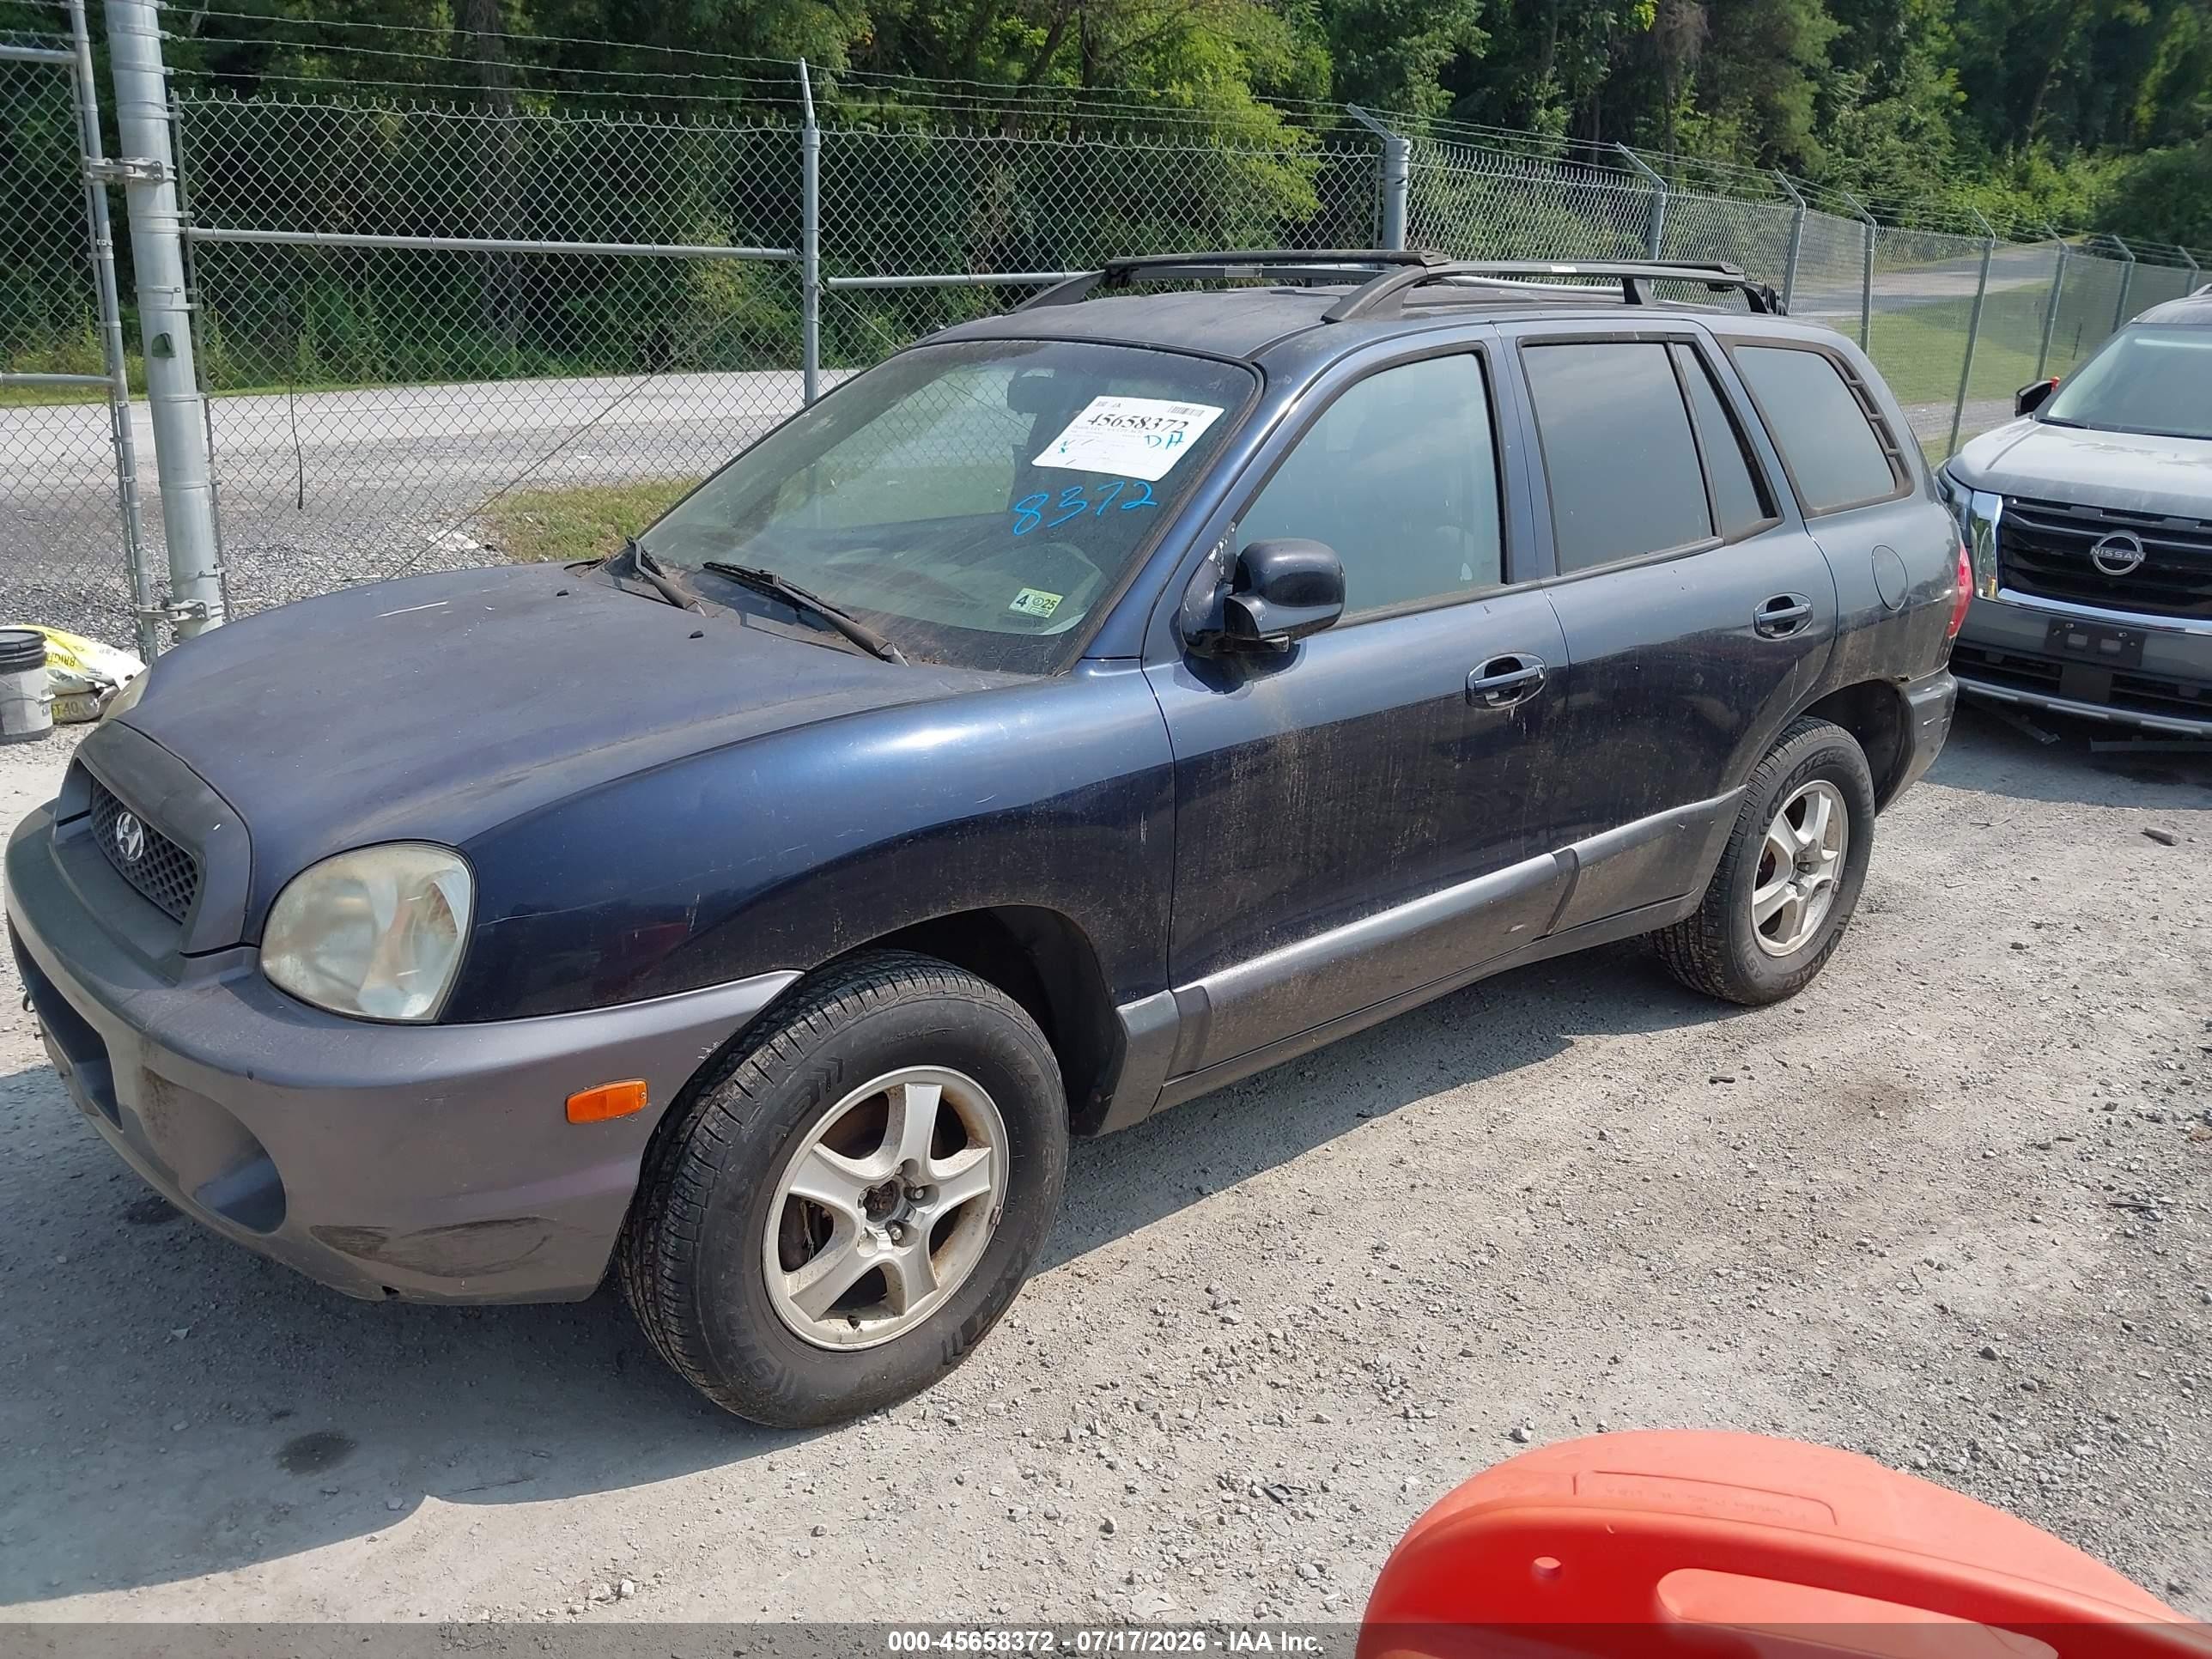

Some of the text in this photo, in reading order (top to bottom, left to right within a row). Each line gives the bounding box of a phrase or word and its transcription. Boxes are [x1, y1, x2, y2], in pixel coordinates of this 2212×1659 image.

[1087, 413, 1189, 433] 45658372
[1012, 481, 1158, 536] 8372
[2091, 548, 2144, 561] NISSAN
[1016, 594, 1057, 610] 4 25
